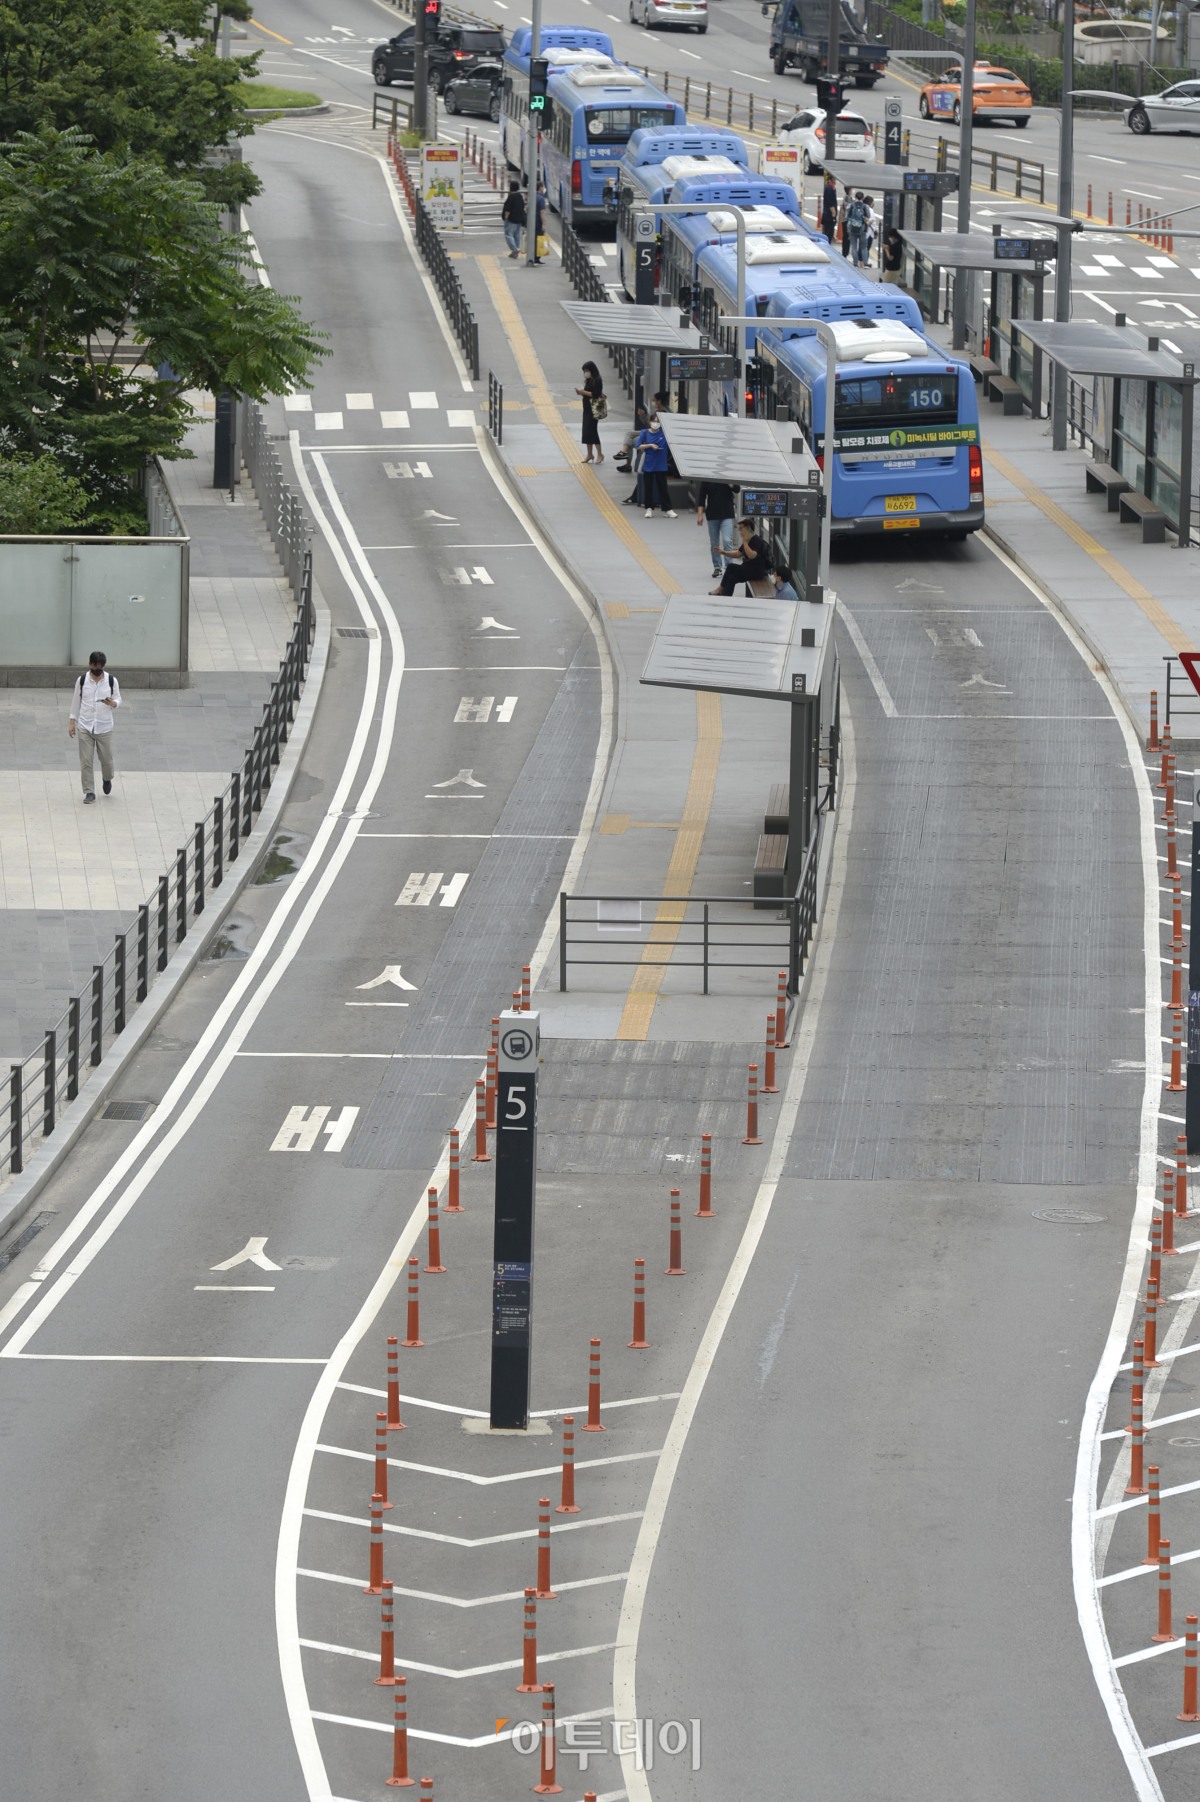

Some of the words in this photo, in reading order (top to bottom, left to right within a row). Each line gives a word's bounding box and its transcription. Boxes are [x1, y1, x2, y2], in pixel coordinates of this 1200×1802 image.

[888, 126, 900, 142] 4
[640, 248, 652, 266] 5
[910, 389, 943, 408] 150
[817, 438, 841, 449] 뿌는
[841, 436, 866, 448] 탈모증
[866, 434, 890, 446] 치료제
[907, 432, 938, 443] 미녹시딜
[938, 429, 977, 441] 바이그루트
[505, 1086, 526, 1120] 5
[497, 1263, 505, 1275] 5
